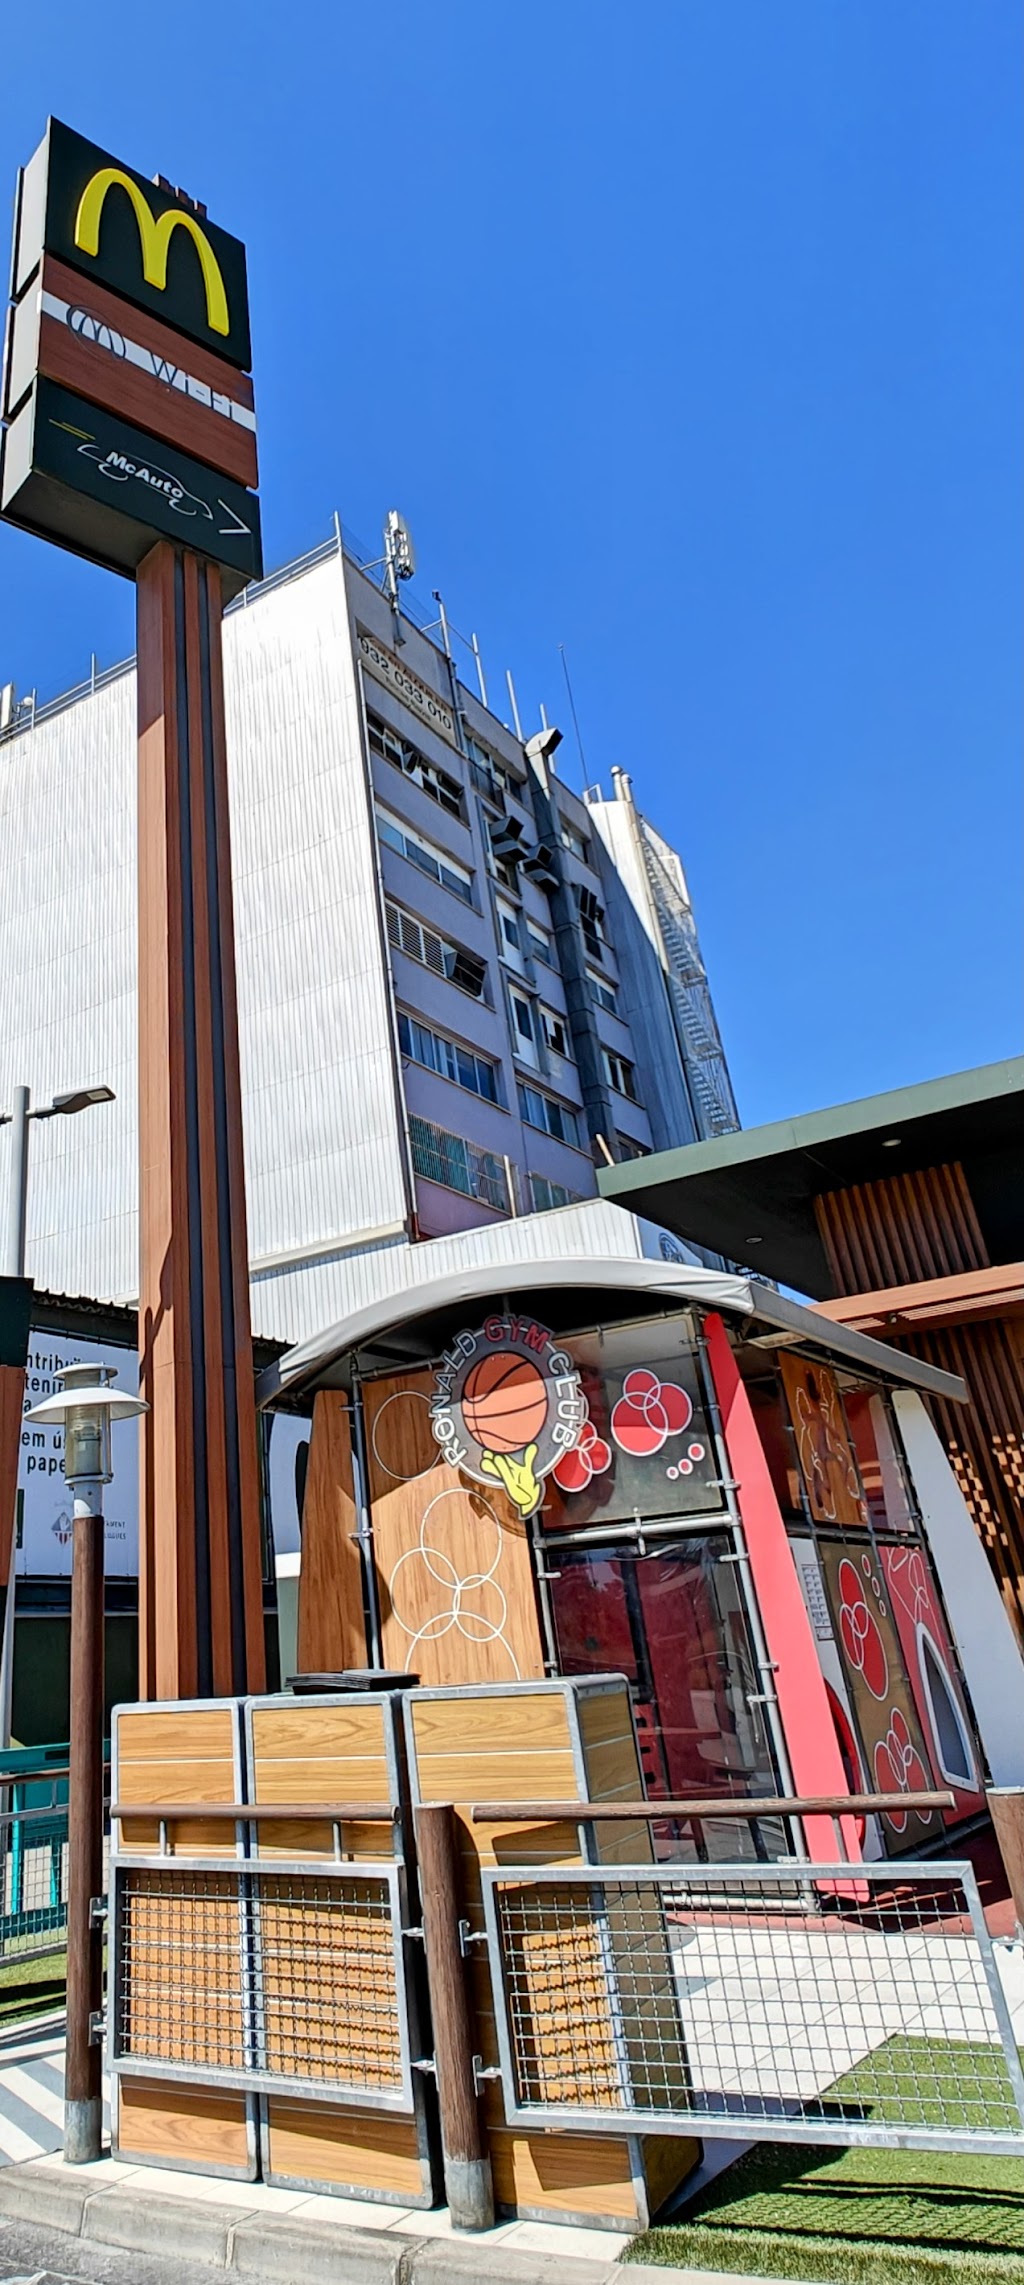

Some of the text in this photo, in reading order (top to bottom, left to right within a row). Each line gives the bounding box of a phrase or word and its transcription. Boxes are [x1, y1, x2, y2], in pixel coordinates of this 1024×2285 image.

[106, 451, 184, 499] McAuto
[394, 670, 424, 705] 033
[427, 700, 452, 730] 010
[25, 1373, 64, 1394] tenir
[431, 1317, 580, 1467] RONALD GYM CLUB
[22, 1431, 45, 1448] em
[27, 1455, 65, 1477] pape
